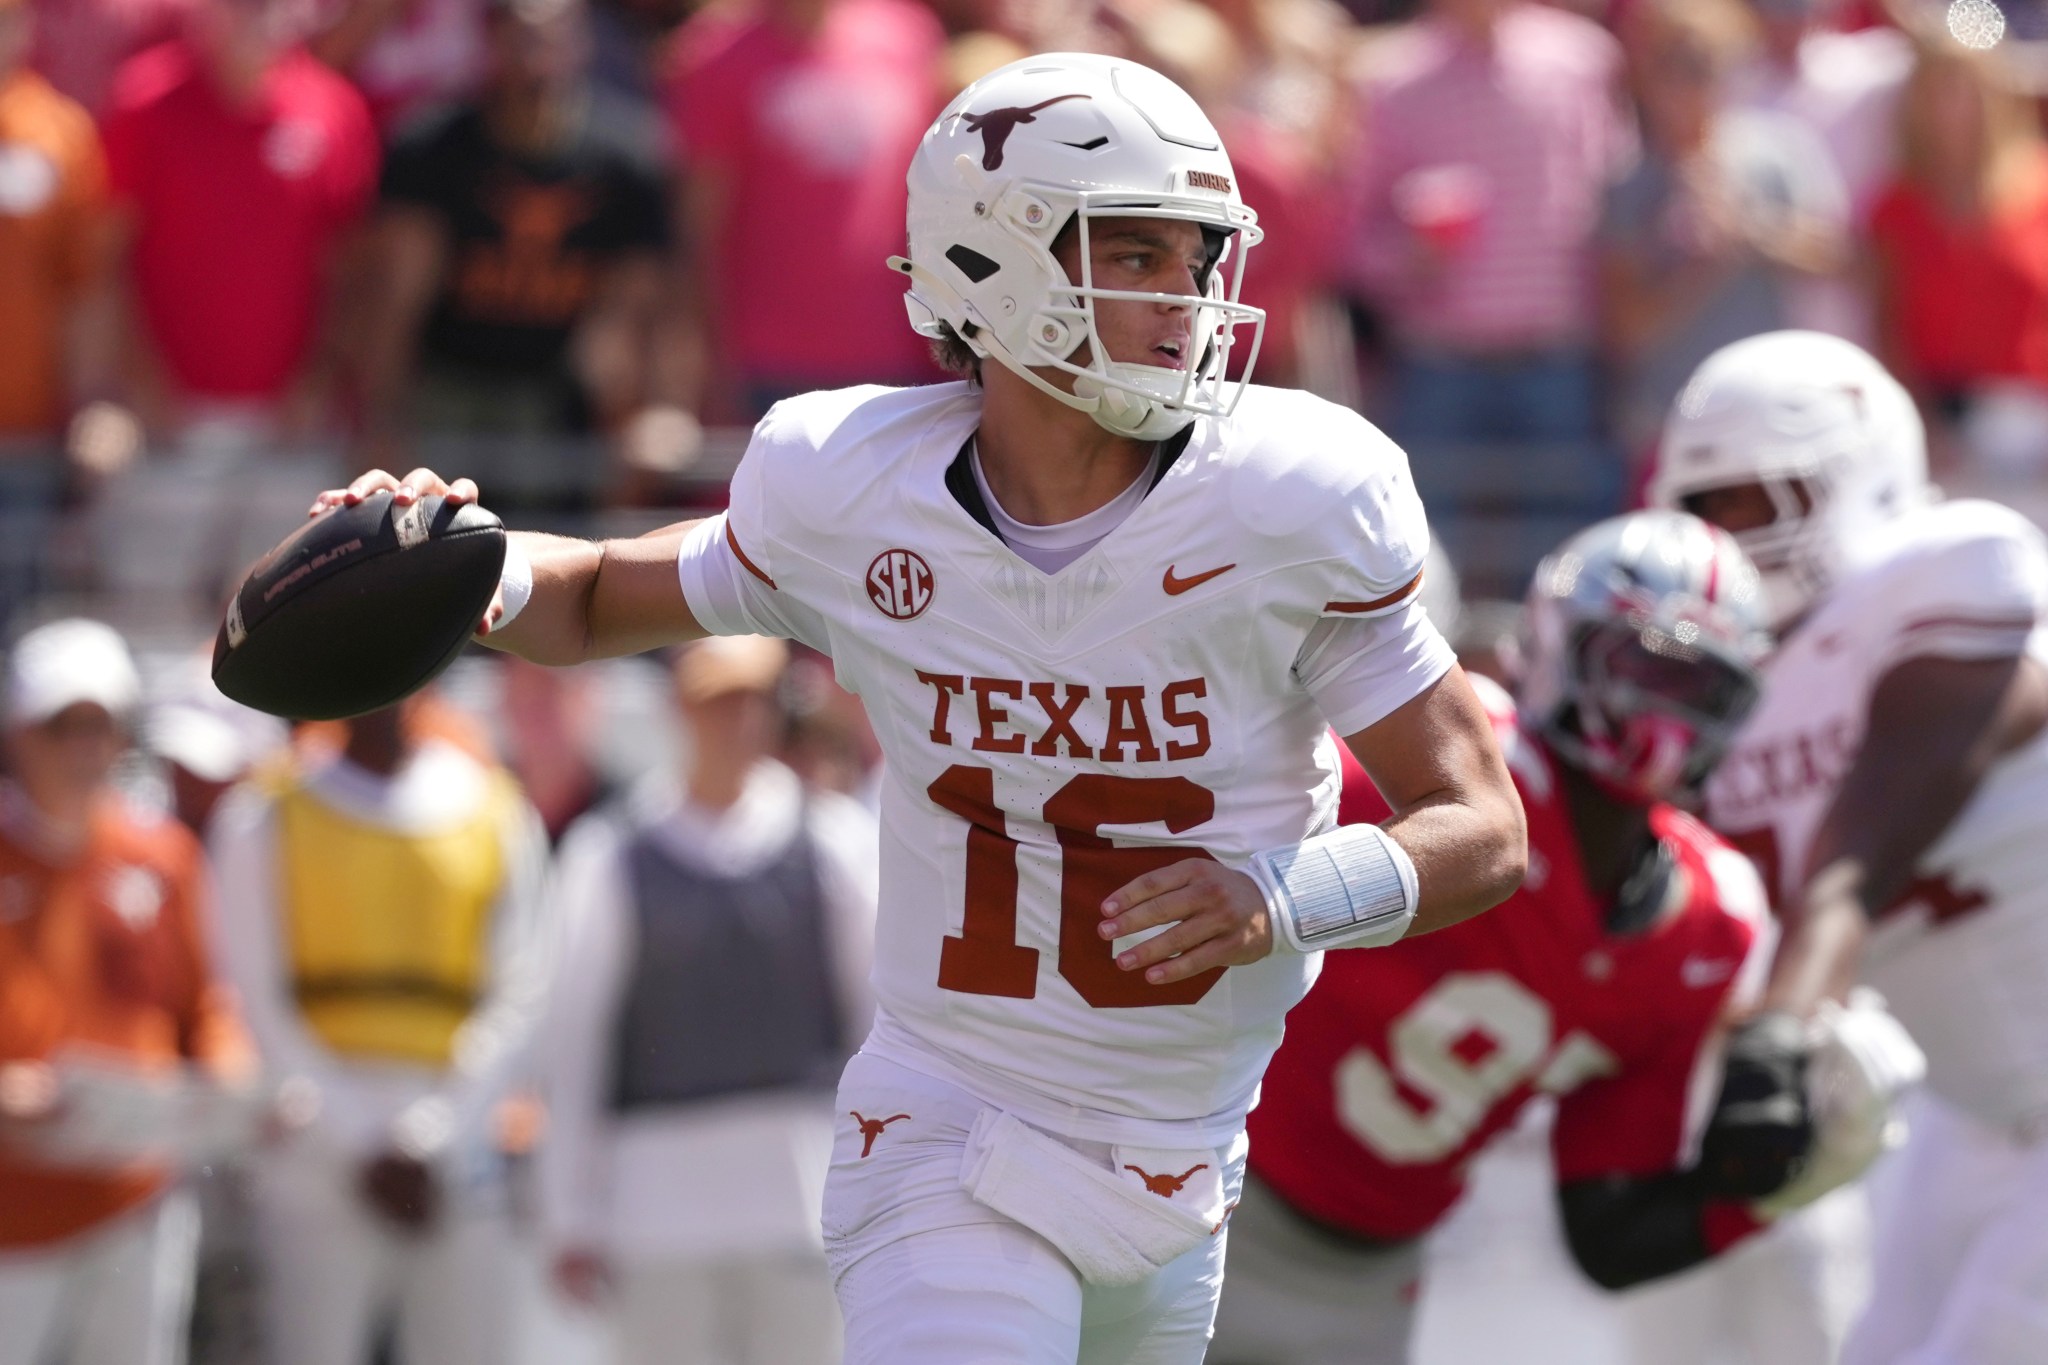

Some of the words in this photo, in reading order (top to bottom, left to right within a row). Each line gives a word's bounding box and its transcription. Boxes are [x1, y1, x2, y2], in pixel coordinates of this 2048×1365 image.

[1187, 170, 1231, 193] HORNS
[869, 551, 931, 616] SEC
[915, 669, 1212, 763] TEXAS
[927, 763, 1228, 1008] 16
